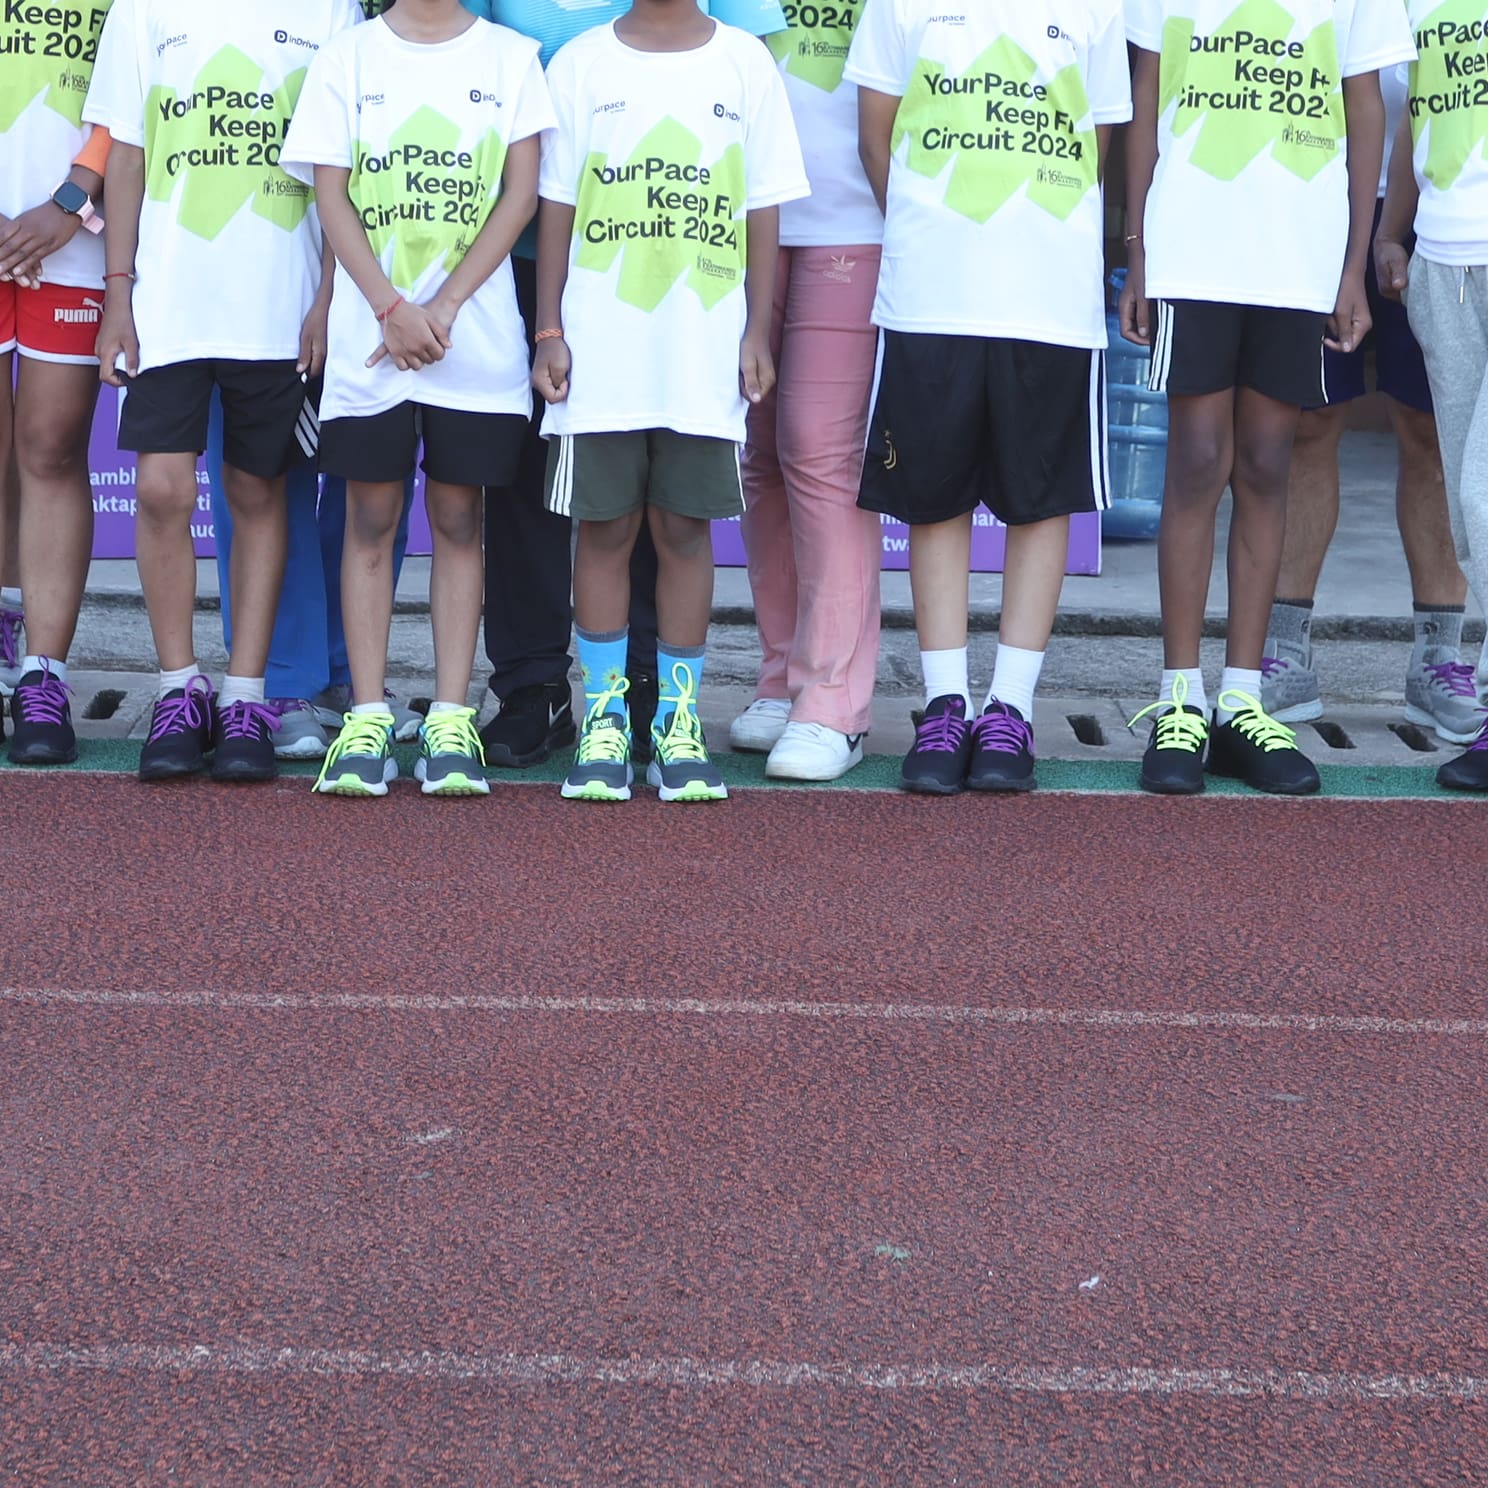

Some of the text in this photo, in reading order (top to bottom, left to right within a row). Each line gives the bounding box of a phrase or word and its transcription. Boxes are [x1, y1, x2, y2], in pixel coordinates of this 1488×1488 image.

[4, 0, 81, 33] Keep
[783, 6, 853, 31] 2024
[923, 73, 1047, 101] YourPace
[1234, 59, 1303, 88] Keep
[159, 86, 274, 121] YourPace
[985, 100, 1049, 132] Keep
[209, 114, 276, 144] Keep
[922, 128, 1083, 161] Circuit 2024
[406, 171, 473, 202] Keep
[647, 186, 709, 218] Keep
[585, 214, 737, 250] Circuit 2024
[54, 308, 98, 323] PUMA
[592, 718, 613, 730] SPORT
